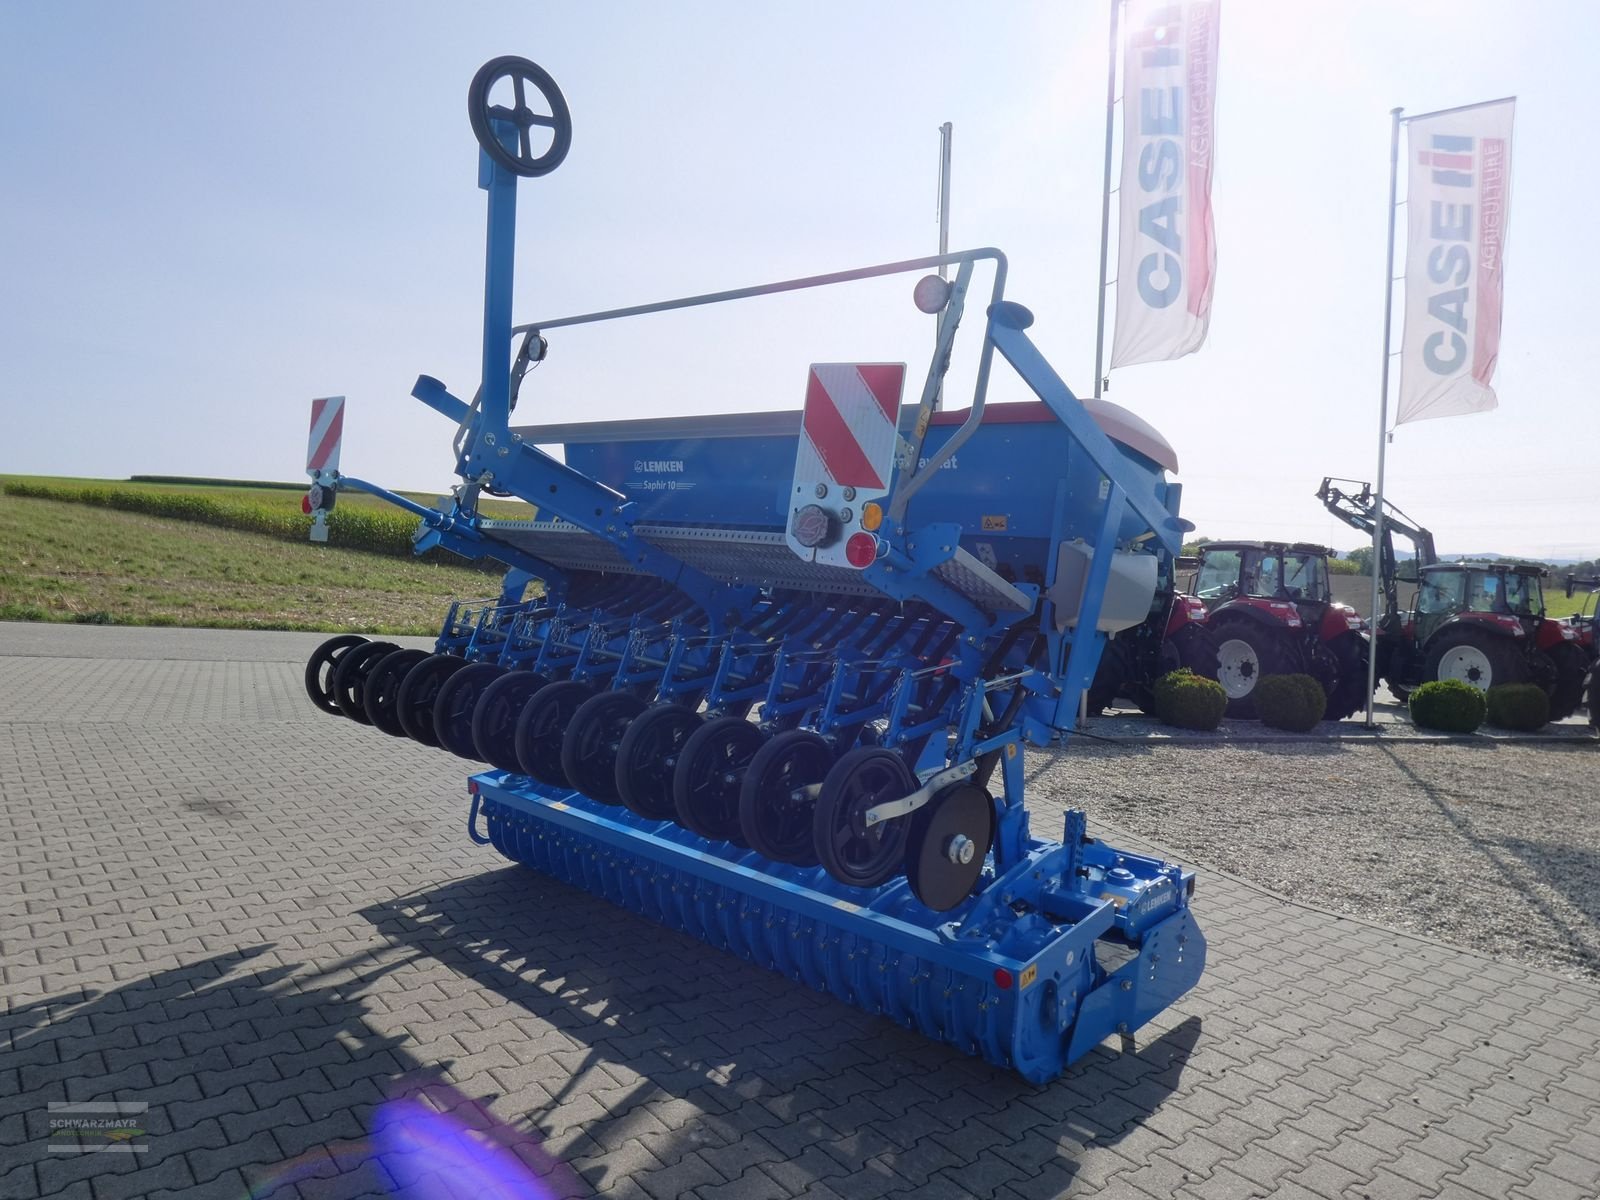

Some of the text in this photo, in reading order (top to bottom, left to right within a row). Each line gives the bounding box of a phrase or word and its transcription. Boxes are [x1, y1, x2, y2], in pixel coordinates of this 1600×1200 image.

[1189, 5, 1211, 169] AGRICULTURE
[1136, 86, 1183, 310] CASE
[1480, 143, 1500, 270] AGRICULTURE
[1423, 200, 1473, 375] CASE
[643, 460, 684, 474] LEMKEN
[643, 480, 677, 492] Saphir 10
